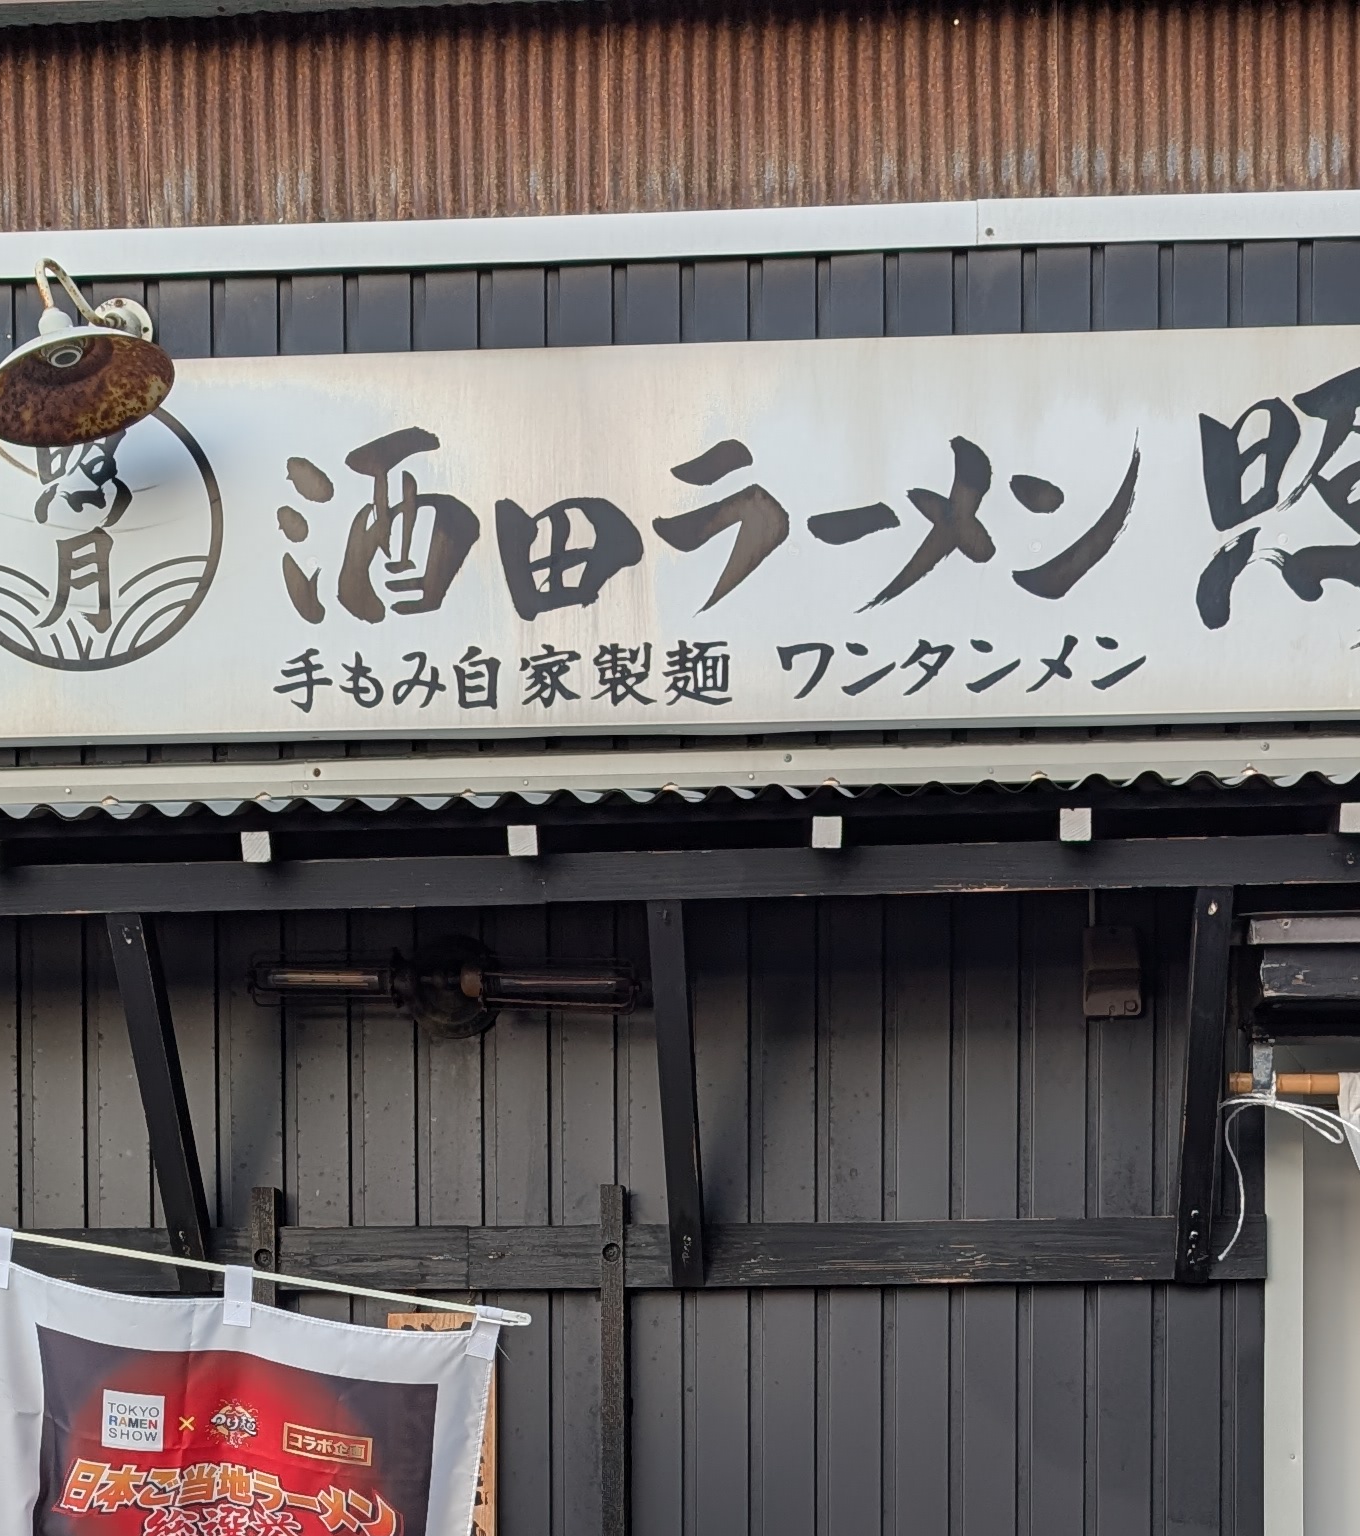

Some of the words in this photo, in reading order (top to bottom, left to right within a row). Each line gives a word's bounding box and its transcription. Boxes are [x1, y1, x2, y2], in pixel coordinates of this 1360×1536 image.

[276, 426, 1142, 624] 酒田ラーメン
[272, 640, 733, 713] 手もみ自家製麺
[776, 634, 1147, 700] ワンタンメン
[107, 1402, 160, 1418] TOKYO
[108, 1415, 158, 1430] RAMEN
[108, 1427, 158, 1441] SHOW
[288, 1432, 366, 1460] コラボ企画
